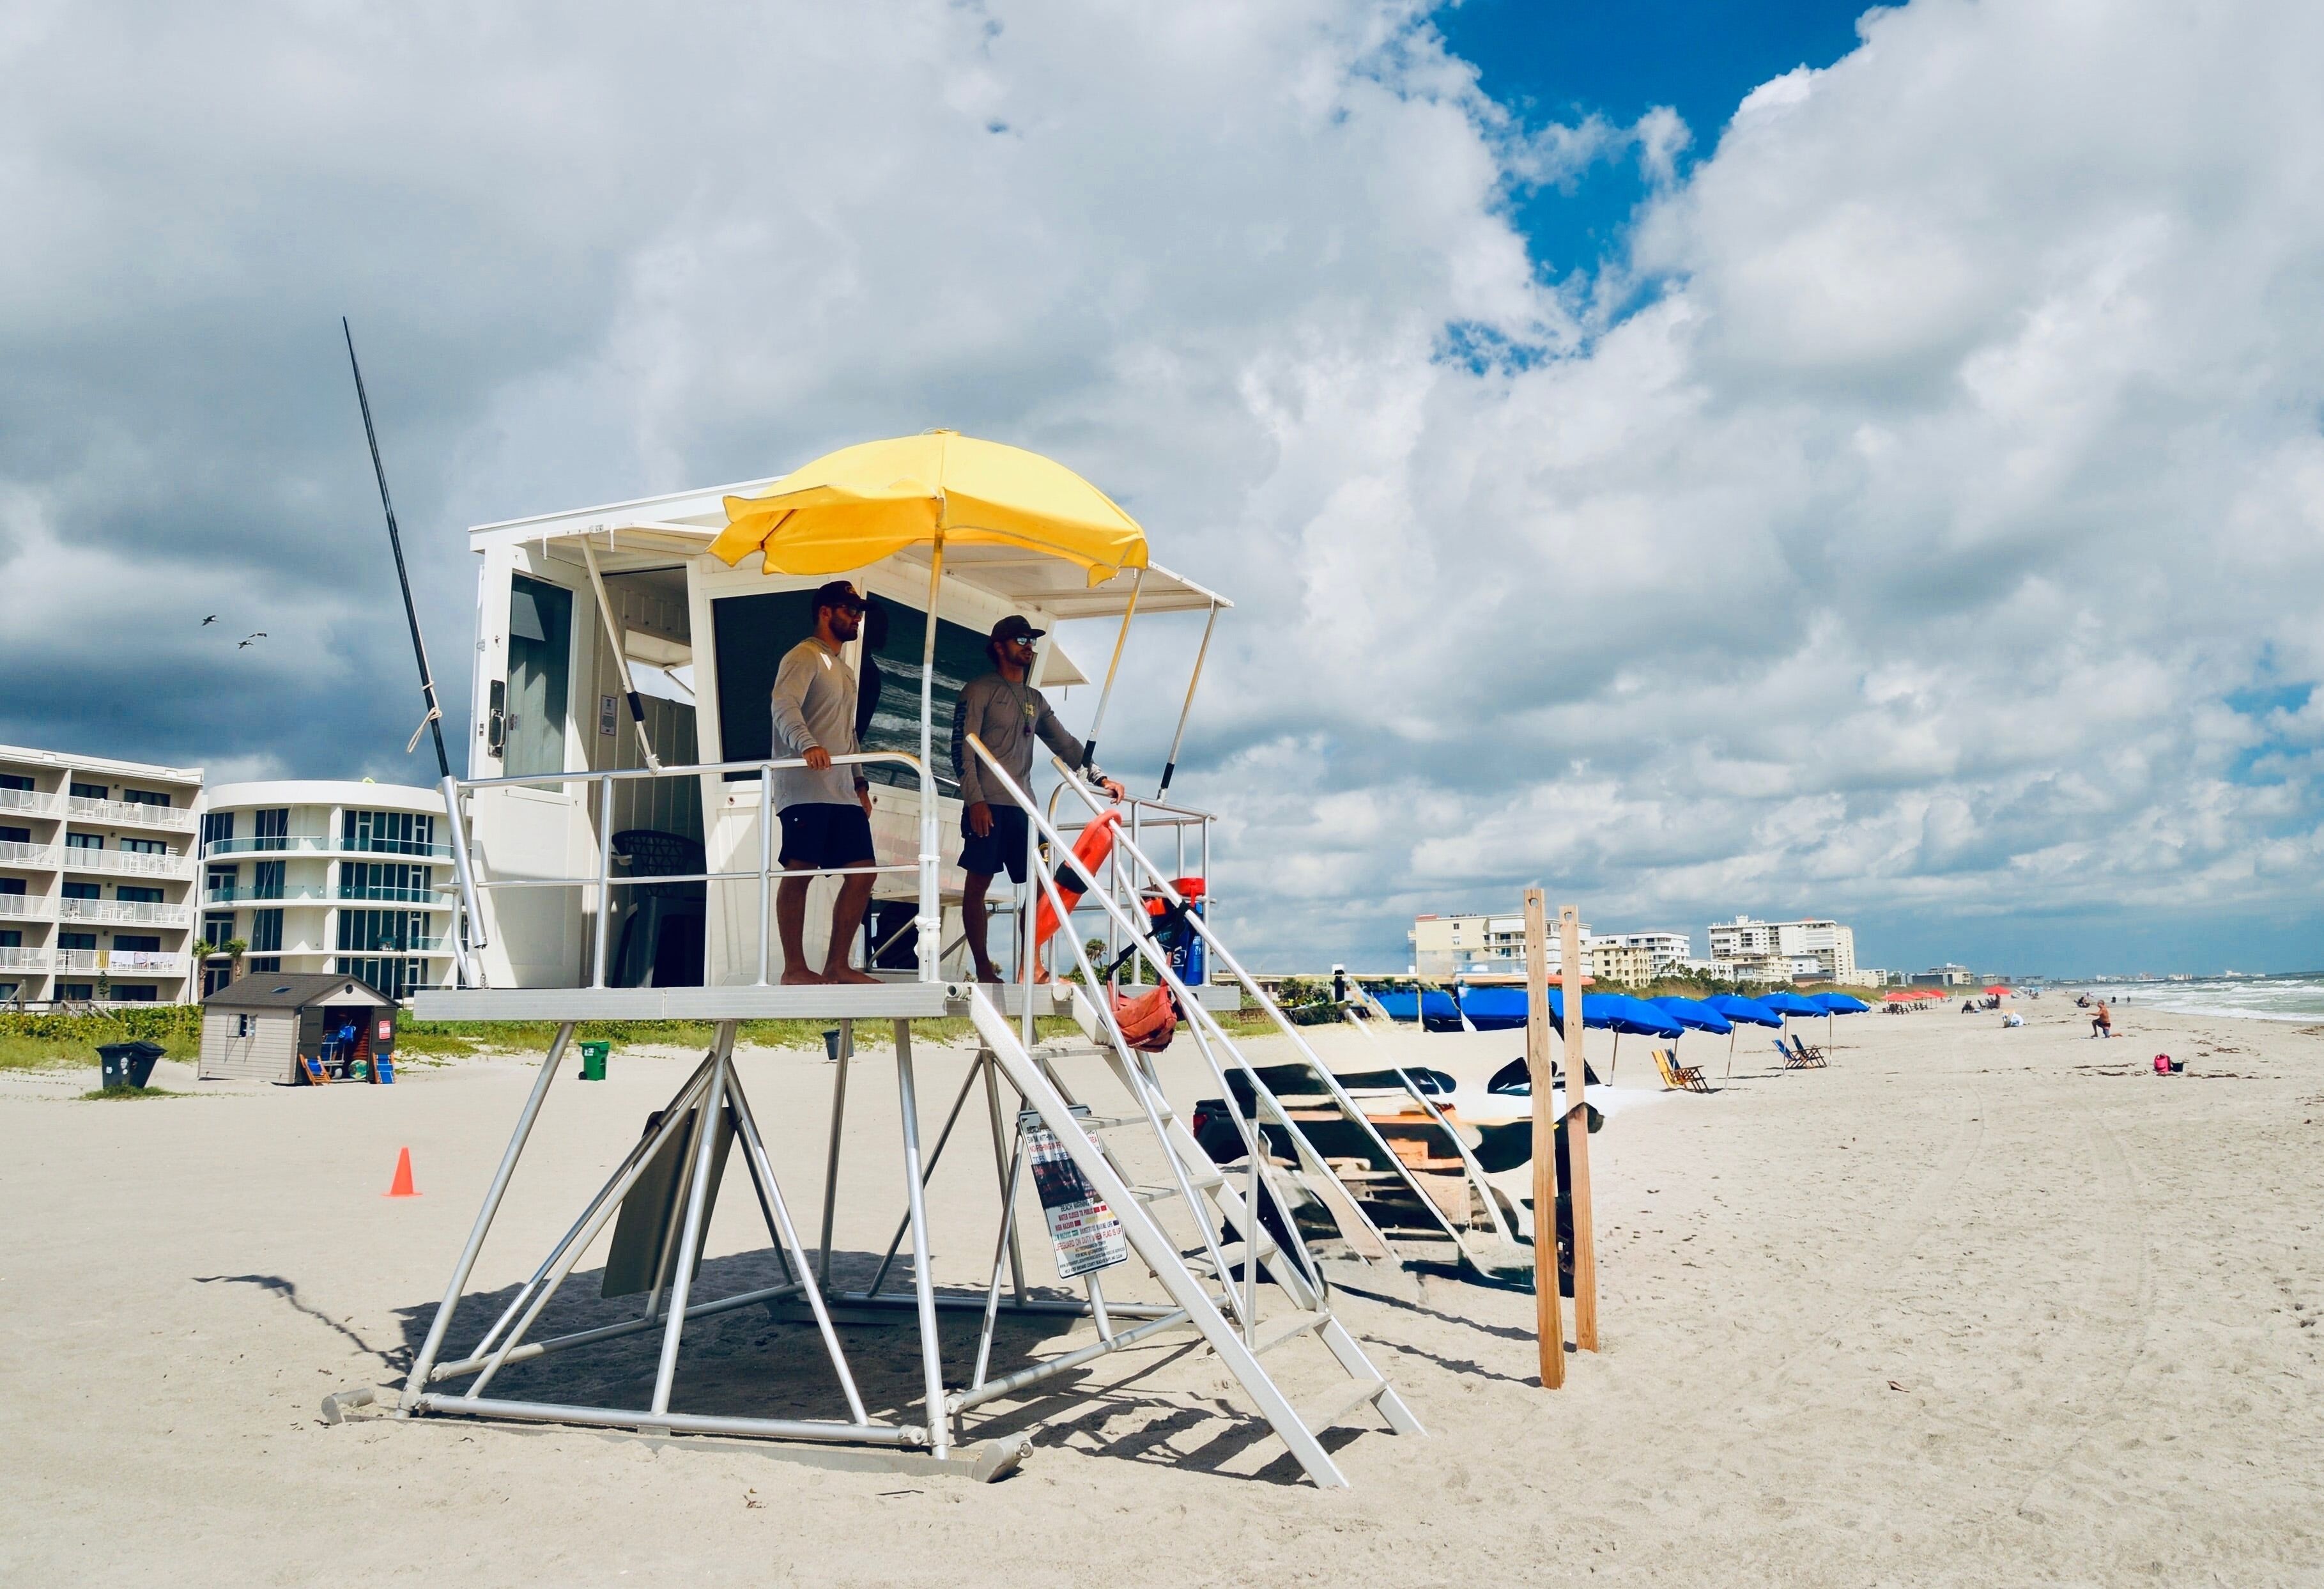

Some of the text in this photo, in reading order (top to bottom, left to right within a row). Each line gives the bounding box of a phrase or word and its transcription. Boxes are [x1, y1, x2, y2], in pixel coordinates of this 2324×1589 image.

[1027, 1135, 1038, 1143] SWIM
[1061, 1203, 1073, 1212] BEACH
[1074, 1200, 1089, 1209] WARNING
[1056, 1239, 1075, 1251] LIFEGUARD
[1075, 1237, 1081, 1246] ON
[1081, 1234, 1091, 1244] DUTY
[1090, 1232, 1102, 1243] WHEN
[1102, 1229, 1112, 1239] FLAG
[1116, 1227, 1122, 1235] UP
